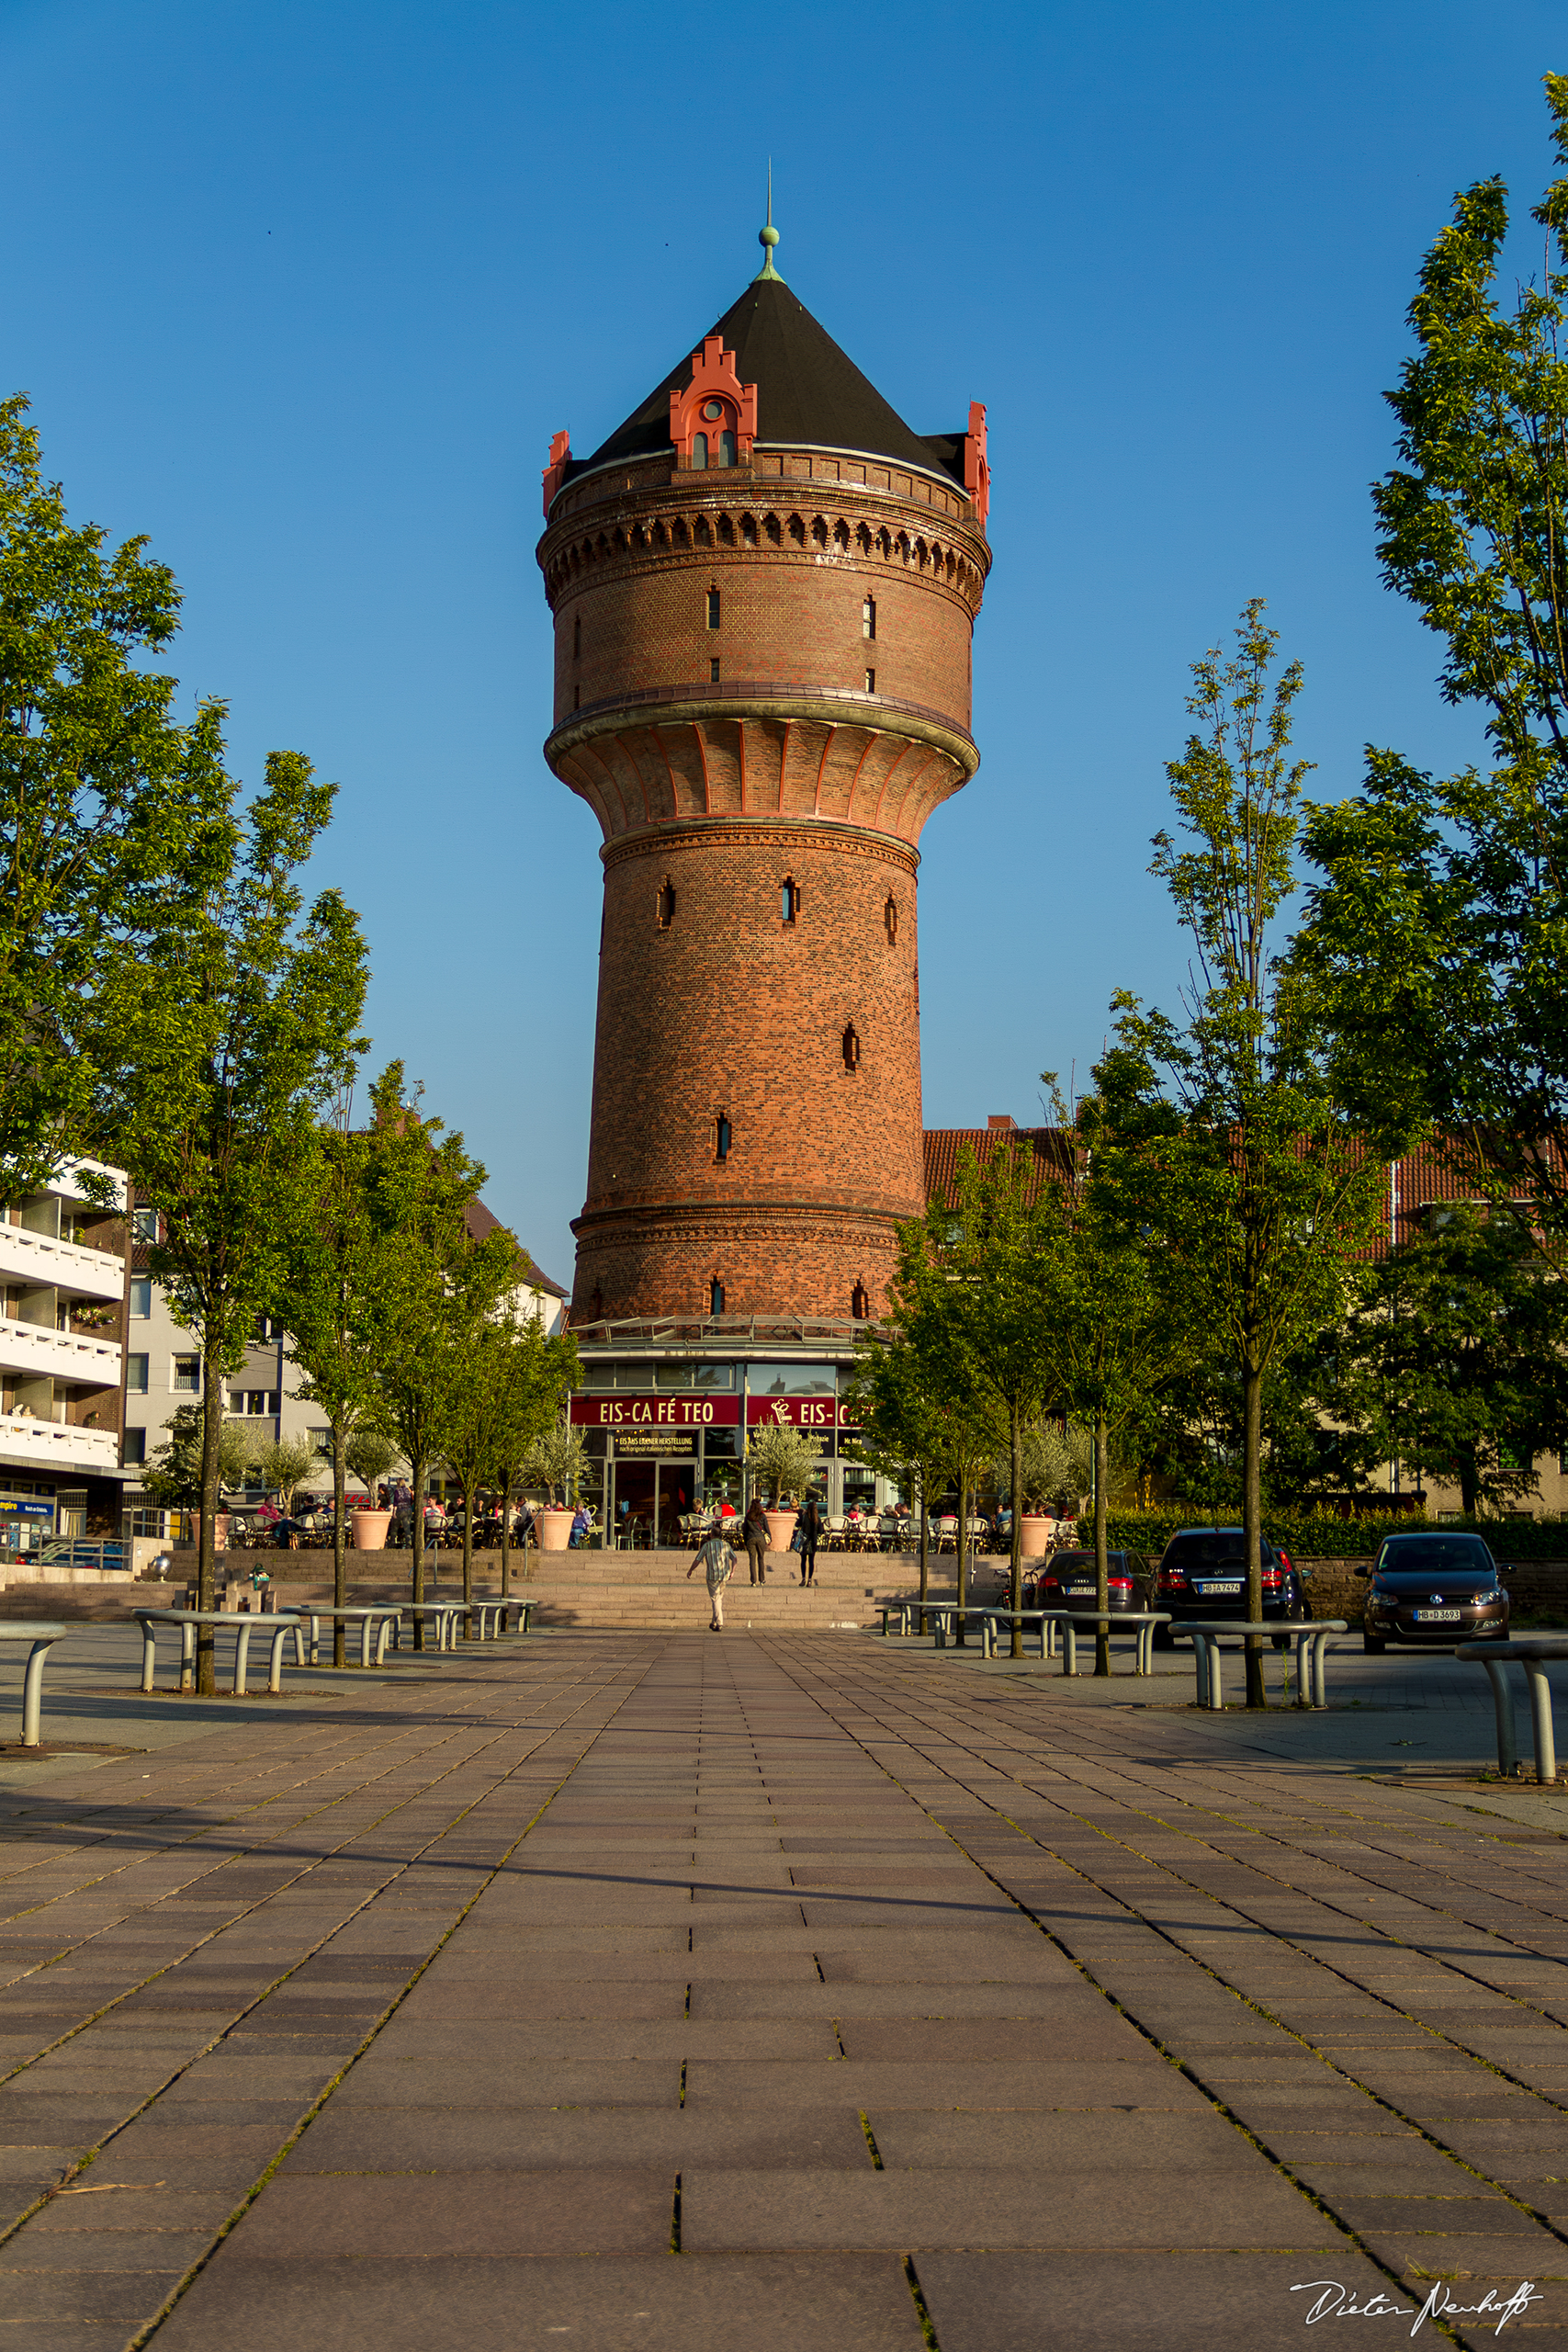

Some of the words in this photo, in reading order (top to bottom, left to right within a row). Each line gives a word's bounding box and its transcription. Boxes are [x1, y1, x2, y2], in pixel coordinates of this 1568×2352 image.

[682, 1402, 714, 1422] TEO
[619, 1437, 627, 1445] EIS
[627, 1437, 638, 1445] AUS
[638, 1437, 659, 1445] EIGENER
[659, 1437, 693, 1445] HERSTELLUNG
